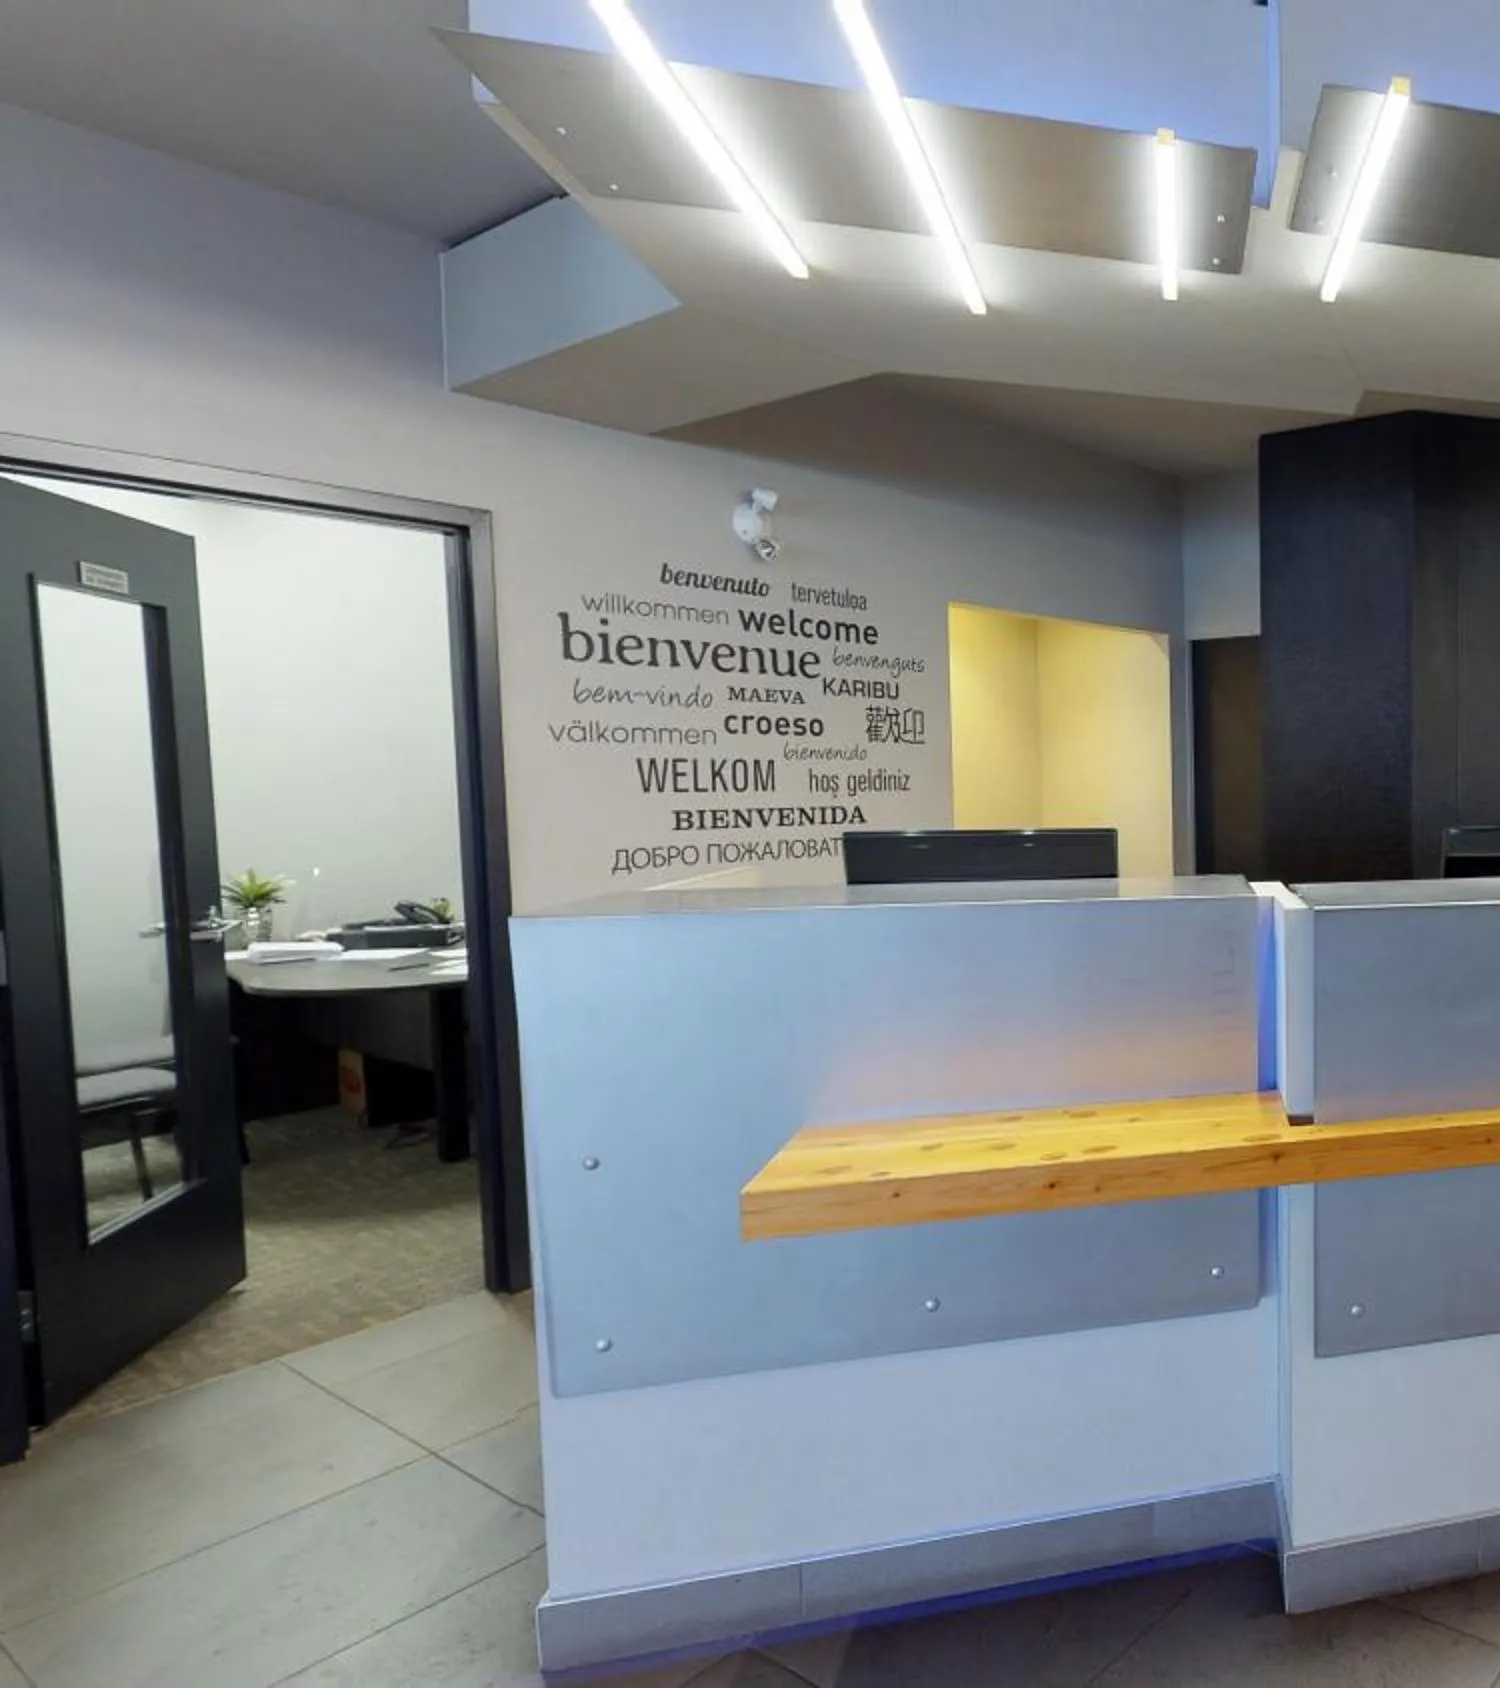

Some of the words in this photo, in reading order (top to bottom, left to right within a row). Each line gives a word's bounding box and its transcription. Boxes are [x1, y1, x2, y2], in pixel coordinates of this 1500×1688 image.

[660, 563, 770, 597] benvenuto
[581, 592, 730, 625] willkommen
[792, 582, 868, 611] tervetuloa
[738, 608, 879, 645] welcome
[557, 611, 822, 679] bienvenue
[833, 647, 926, 678] benvenguts
[573, 677, 714, 709] bem-vindo
[726, 686, 806, 705] MAEVA
[823, 678, 900, 700] KARIBU
[548, 719, 718, 746] välkommen
[724, 713, 825, 737] croeso
[783, 740, 868, 762] bienvenido
[636, 757, 775, 793] WELKOM
[809, 768, 840, 798] hoş
[847, 767, 911, 797] geldiniz
[671, 805, 868, 831] BIENVENIDA
[612, 845, 700, 876] ДОБРО
[706, 836, 844, 865] ПОЖАЛОВАТ
